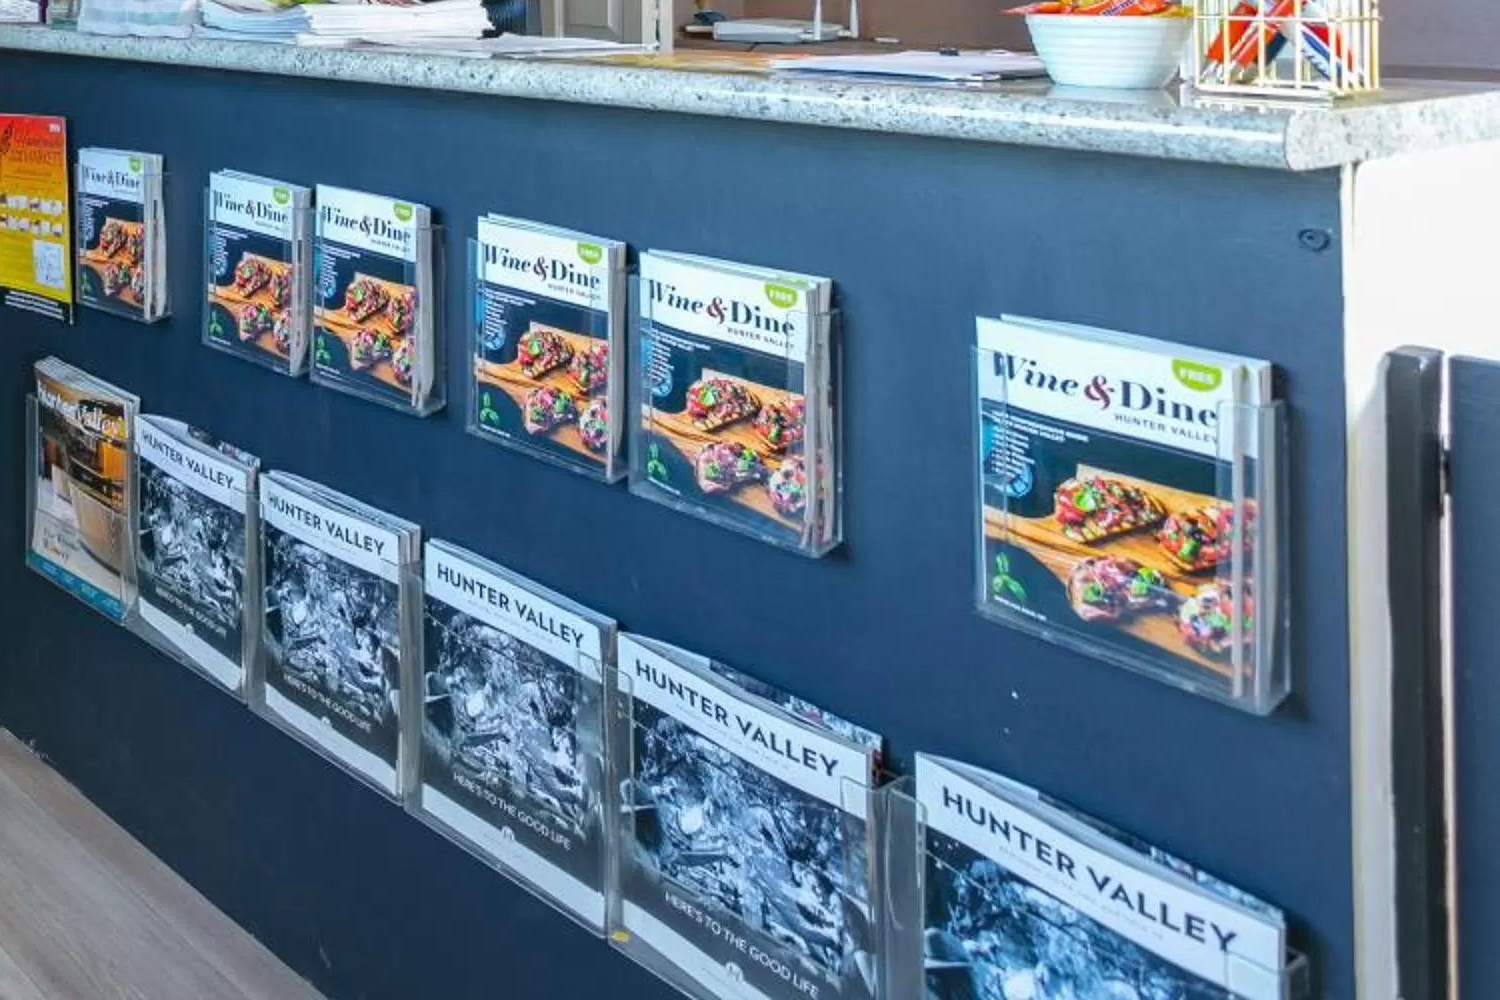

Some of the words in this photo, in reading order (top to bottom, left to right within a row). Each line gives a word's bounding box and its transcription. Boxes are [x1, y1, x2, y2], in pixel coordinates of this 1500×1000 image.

[321, 205, 359, 230] Wine
[374, 218, 412, 243] Dine
[483, 243, 532, 273] Wine
[550, 259, 601, 290] Dine
[648, 279, 703, 314] Wine
[729, 300, 796, 337] Dine
[992, 351, 1079, 397] Wine
[1120, 379, 1218, 427] Dine
[1178, 367, 1216, 387] FREE
[141, 426, 184, 468] HUNTER
[185, 449, 235, 490] VALLEY
[1113, 413, 1168, 433] HUNTER
[1169, 426, 1219, 446] VALLEY
[268, 494, 322, 533] HUNTER
[325, 517, 386, 558] VALLEY
[436, 562, 511, 612] HUNTER
[514, 602, 585, 649] VALLEY
[635, 657, 730, 730] HUNTER
[736, 713, 841, 778] VALLEY
[517, 811, 549, 837] GOOD
[550, 830, 572, 851] LIFE
[941, 784, 1077, 879] HUNTER
[1085, 865, 1238, 952] VALLEY
[704, 915, 722, 935] TO
[723, 928, 747, 953] THE
[750, 946, 792, 981] GOOD
[793, 973, 820, 999] LIFE
